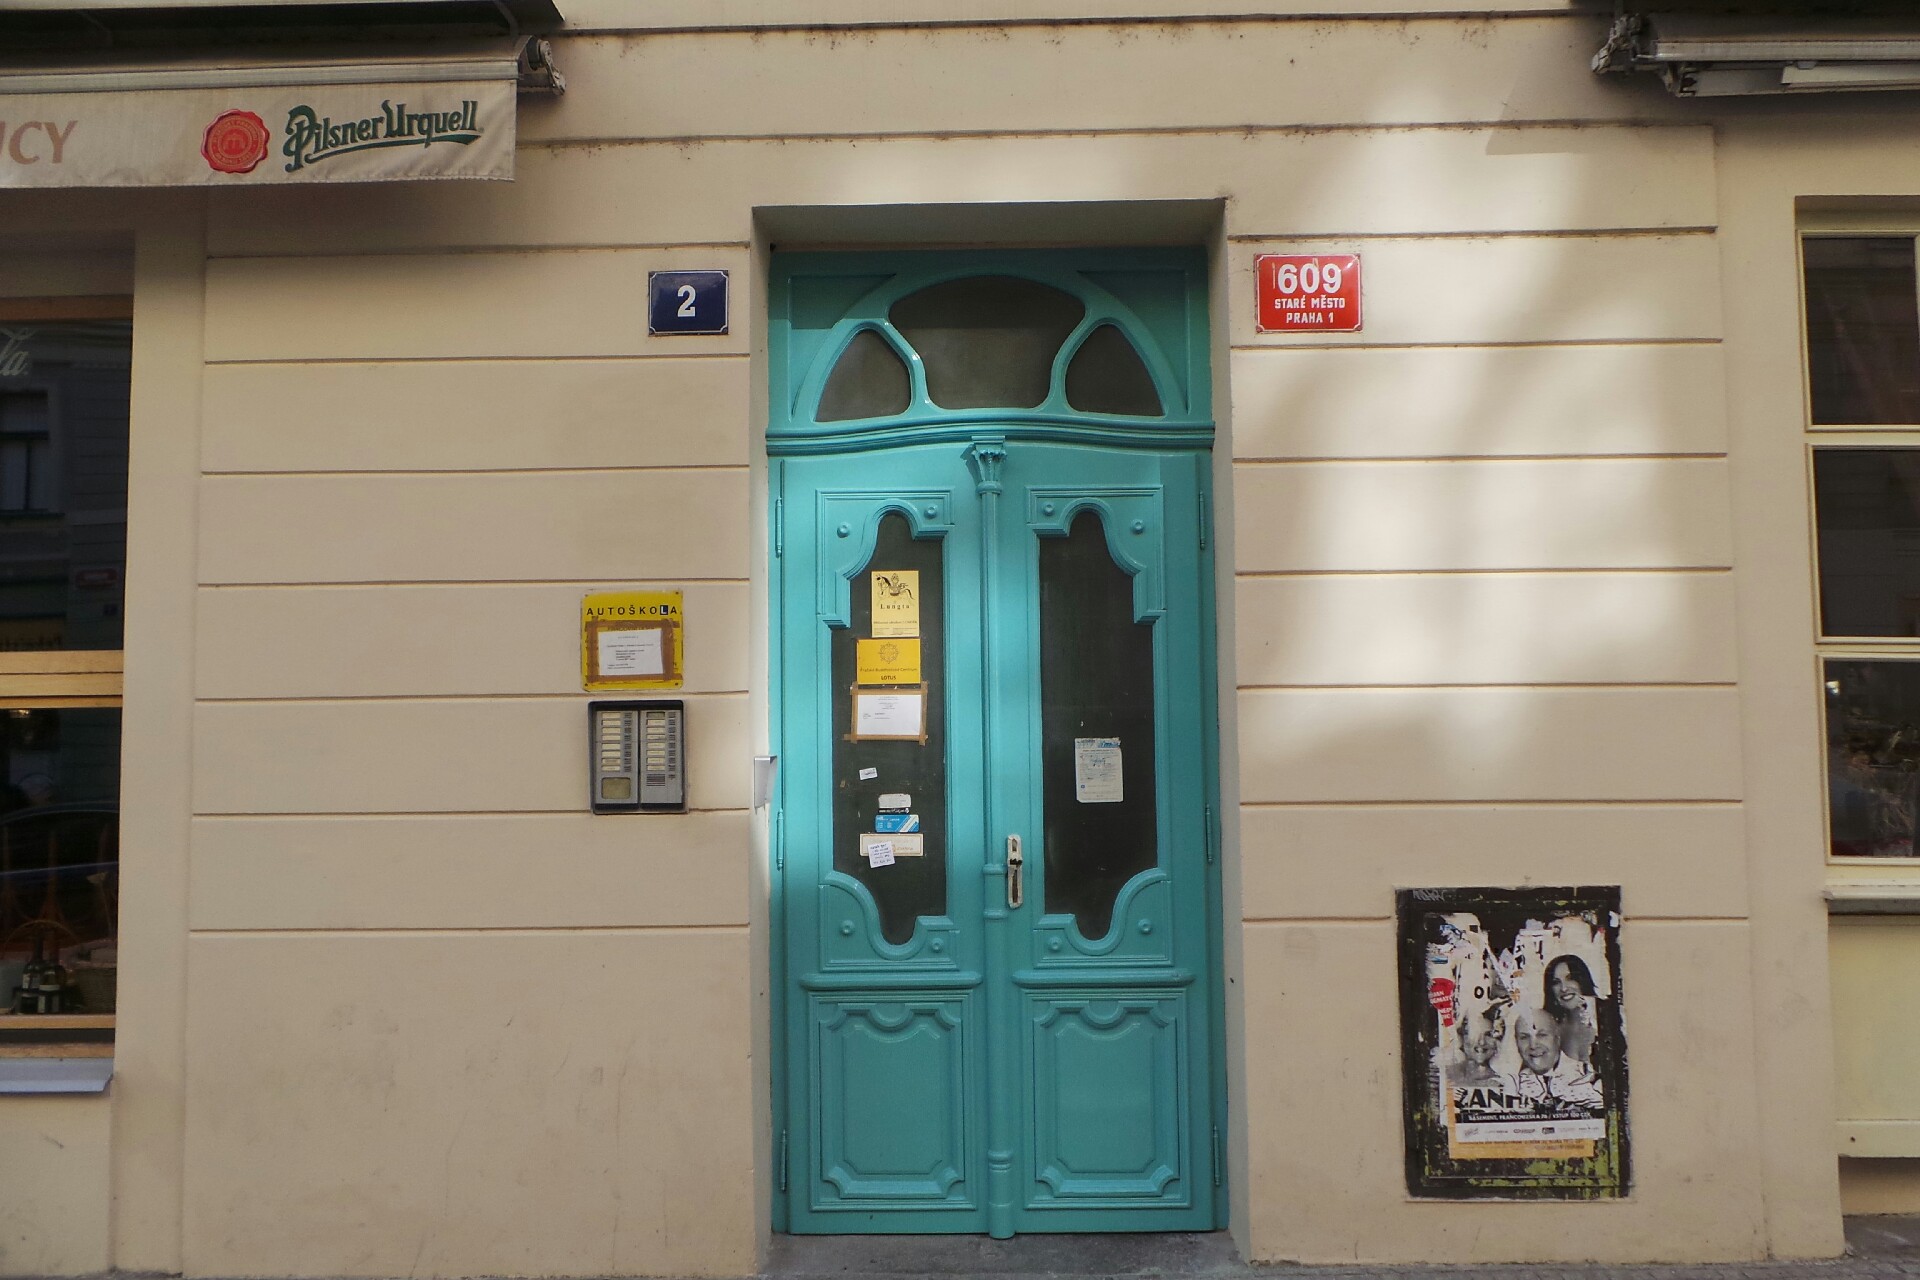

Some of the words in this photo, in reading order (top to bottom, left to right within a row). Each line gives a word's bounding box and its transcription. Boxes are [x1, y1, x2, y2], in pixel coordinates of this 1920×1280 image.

[0, 120, 79, 165] CY
[283, 104, 385, 173] Pilsner
[381, 100, 479, 148] Urquell
[1277, 262, 1342, 294] 609
[677, 284, 696, 318] 2
[1274, 295, 1306, 309] STARÉ
[1311, 294, 1346, 309] MĚSTO
[1286, 312, 1324, 324] PRAHA
[1327, 312, 1335, 324] 1
[586, 604, 678, 616] AUTOŠKOLA
